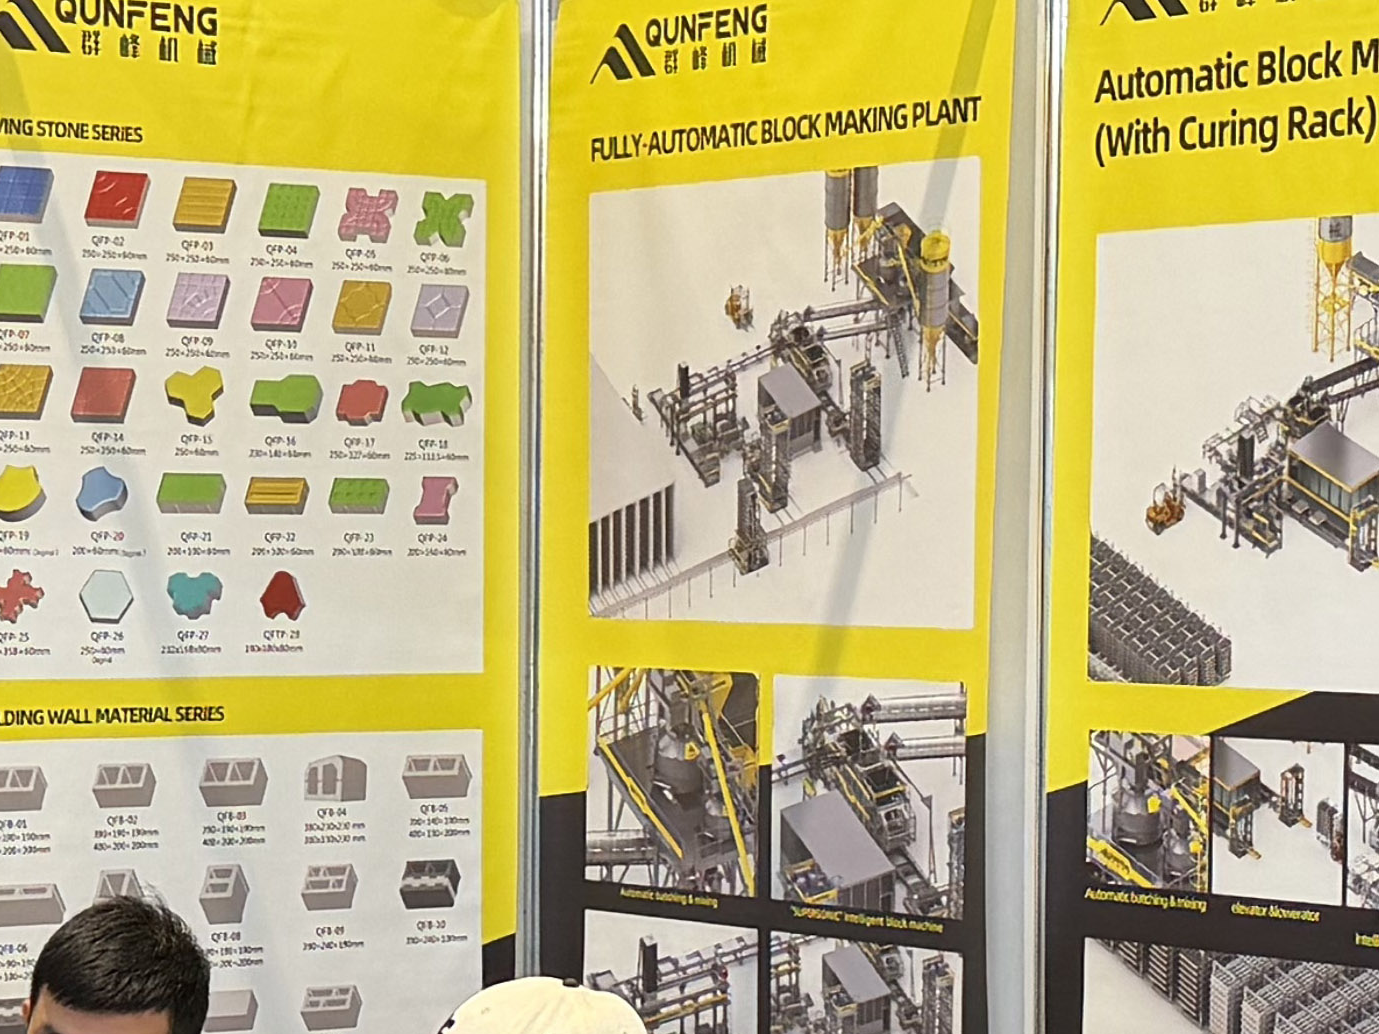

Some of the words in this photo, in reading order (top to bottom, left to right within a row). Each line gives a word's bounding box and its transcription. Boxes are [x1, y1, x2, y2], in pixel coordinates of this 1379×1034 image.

[55, 0, 217, 36] QUNFENG
[646, 4, 767, 47] QUNFENG
[1094, 52, 1249, 103] Automatic
[1258, 40, 1343, 85] Block
[36, 120, 89, 140] STONE
[92, 125, 142, 143] SERIES
[591, 121, 758, 162] FULLY-AUTOMATIC
[761, 113, 821, 144] BLOCK
[825, 104, 907, 138] MAKING
[912, 96, 981, 128] PLANT
[1096, 117, 1170, 167] (With
[1180, 109, 1278, 152] Curing
[1289, 95, 1376, 144] Rack)
[48, 708, 91, 724] WALL
[96, 706, 172, 723] MATERIAL
[175, 706, 224, 721] SERIES
